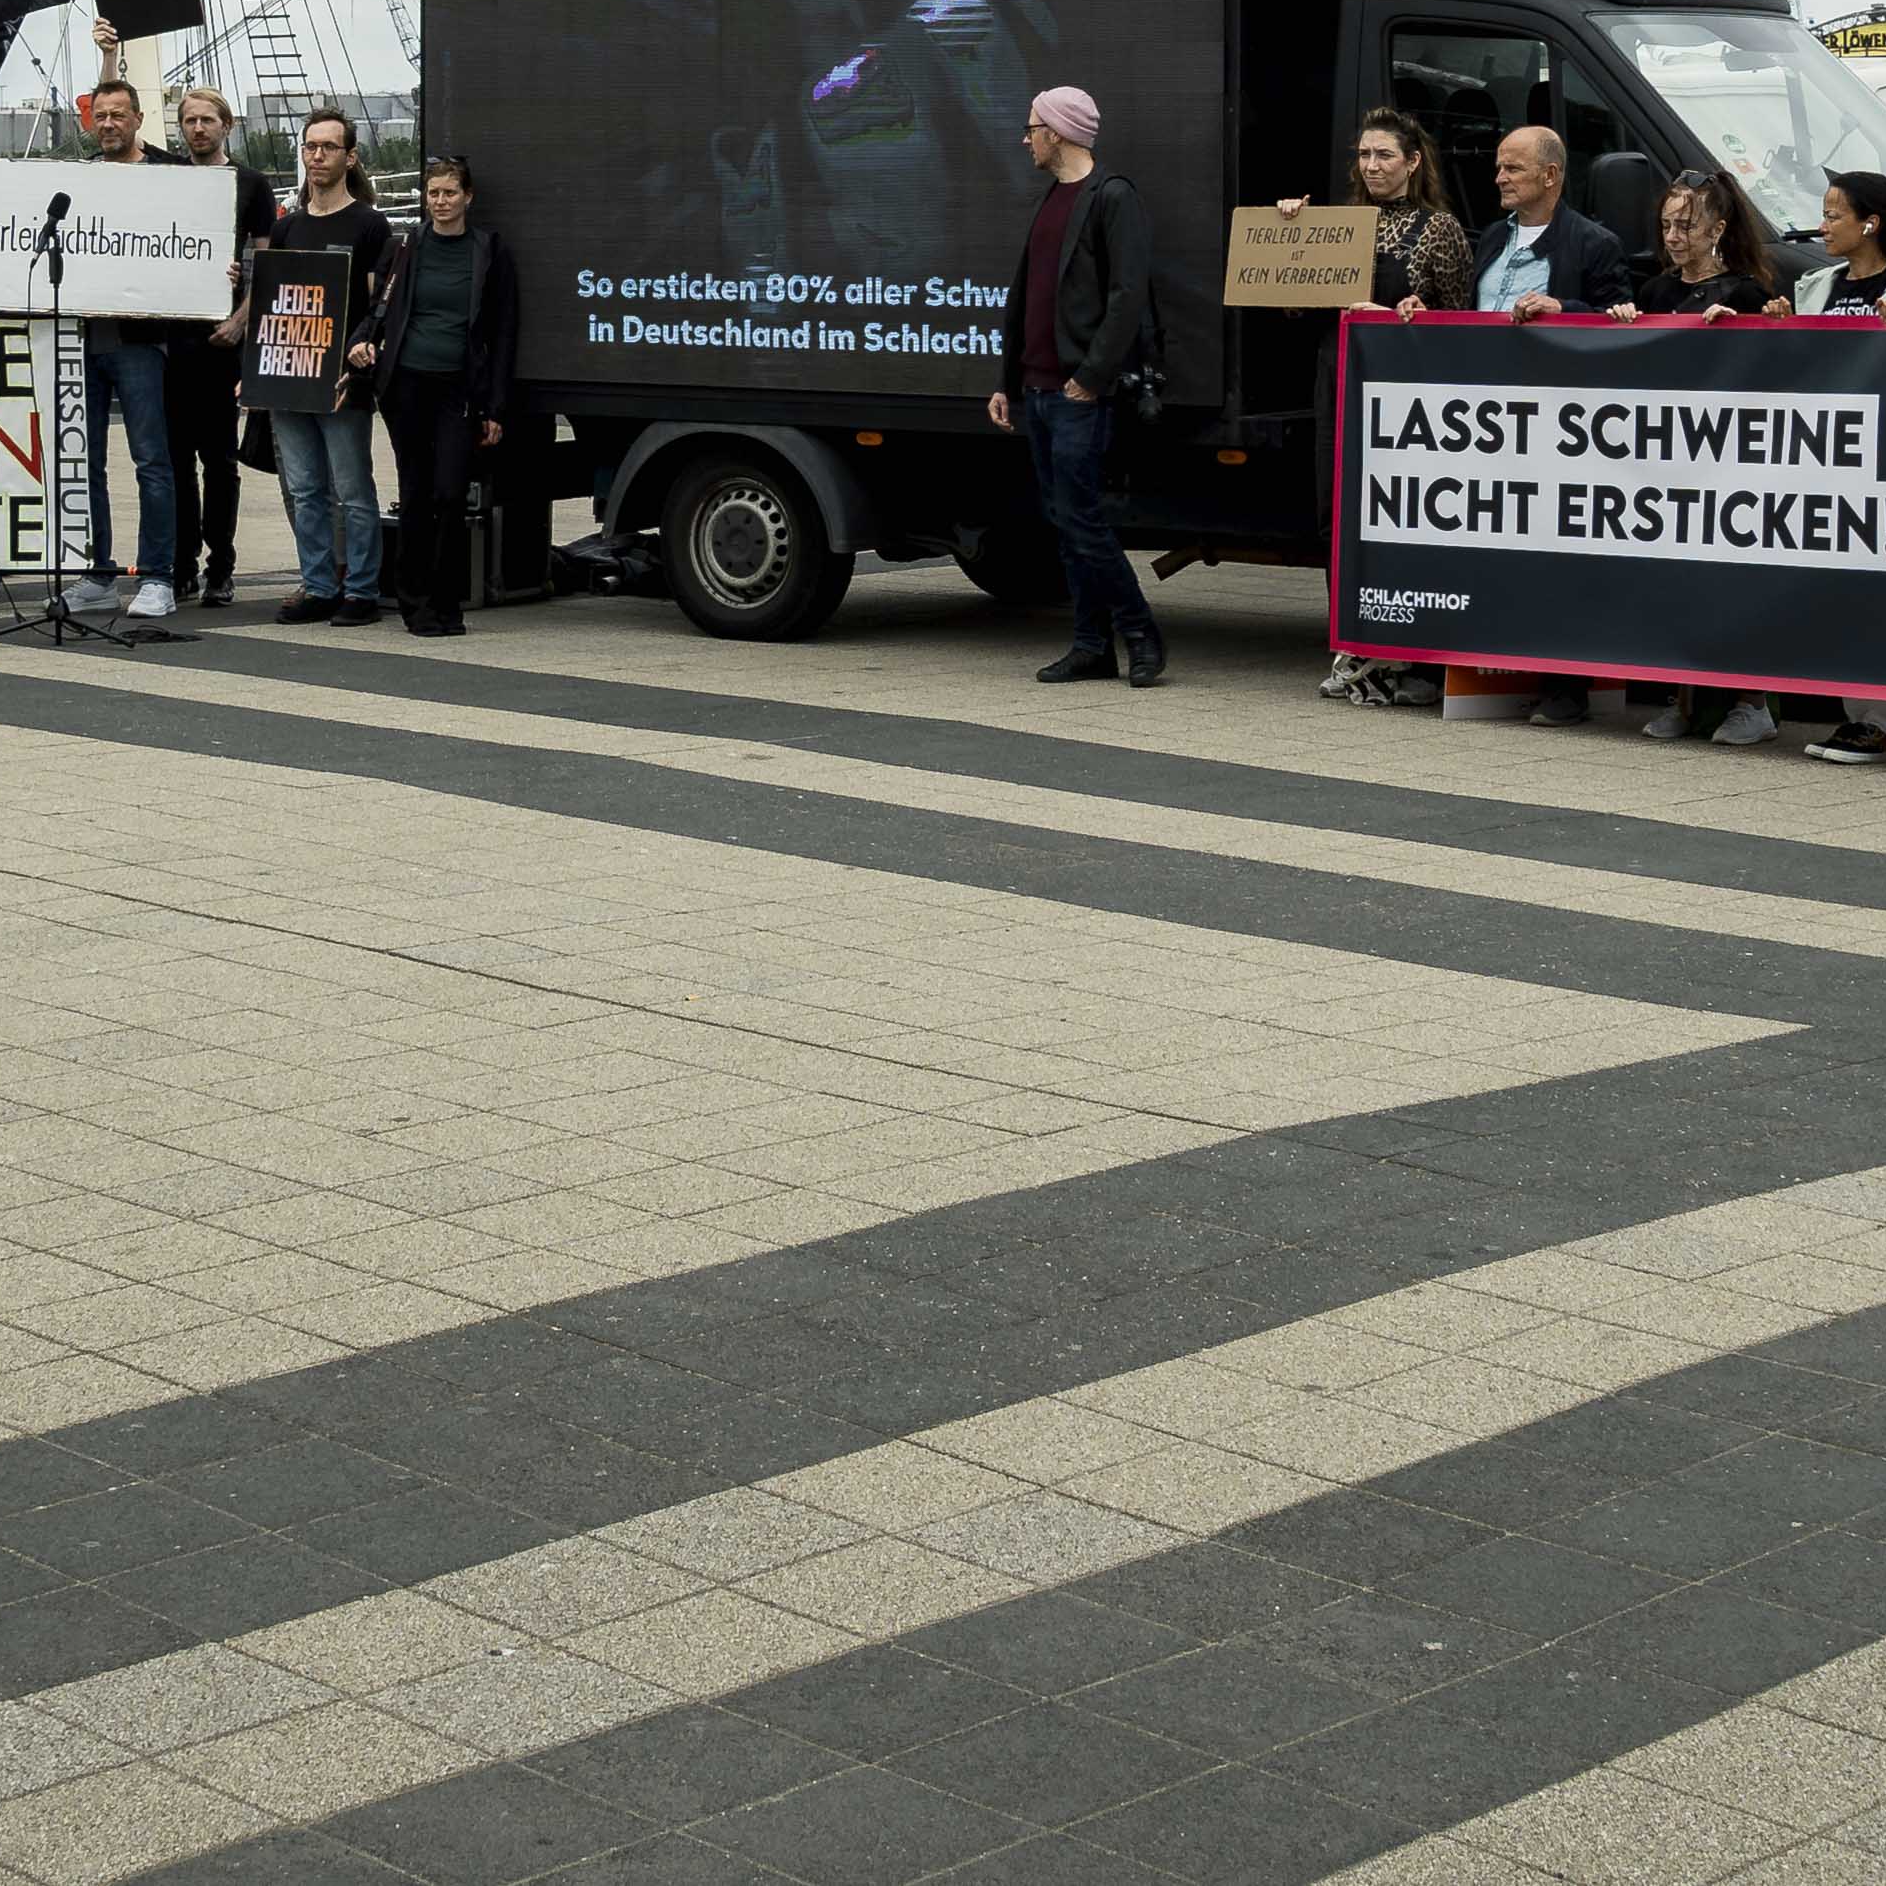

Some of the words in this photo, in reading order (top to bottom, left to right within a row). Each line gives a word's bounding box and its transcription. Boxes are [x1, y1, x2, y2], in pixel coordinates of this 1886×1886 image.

[1245, 227, 1301, 244] TIERLEID
[1305, 226, 1355, 244] ZEIGEN
[1291, 250, 1305, 261] IST
[577, 269, 614, 298] So
[621, 272, 757, 302] ersticken
[765, 273, 837, 304] 80%
[844, 275, 918, 307] aller
[924, 276, 1010, 308] Schw
[1238, 267, 1269, 284] KEIN
[1275, 267, 1361, 284] VERBRECHEN
[272, 284, 325, 316] JEDER
[256, 314, 334, 348] ATEMZUG
[588, 314, 614, 343] in
[622, 315, 811, 350] Deutschland
[818, 321, 855, 351] im
[863, 322, 1003, 356] Schlacht
[258, 345, 326, 378] BRENNT
[1370, 397, 1539, 455] LASST
[1556, 402, 1865, 468] SCHWEINE
[1369, 474, 1539, 536] NICHT
[1358, 603, 1416, 624] PROZESS
[1359, 587, 1470, 611] SCHLACHTHOF
